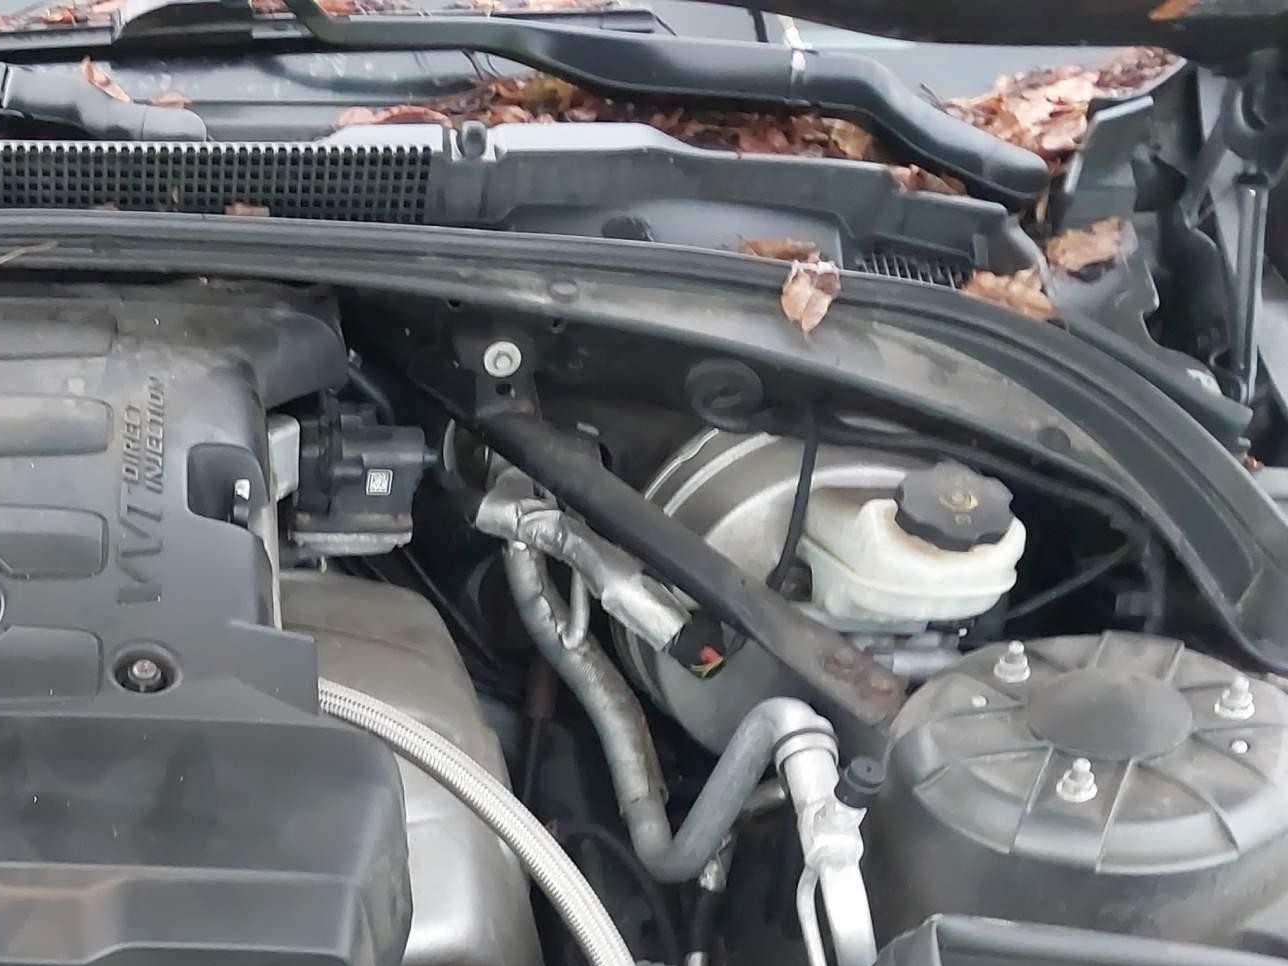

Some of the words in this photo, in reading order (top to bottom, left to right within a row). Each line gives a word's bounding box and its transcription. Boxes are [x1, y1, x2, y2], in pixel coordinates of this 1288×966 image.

[122, 403, 142, 488] DIRECT
[145, 376, 164, 495] INJECTION
[115, 481, 163, 605] VVT
